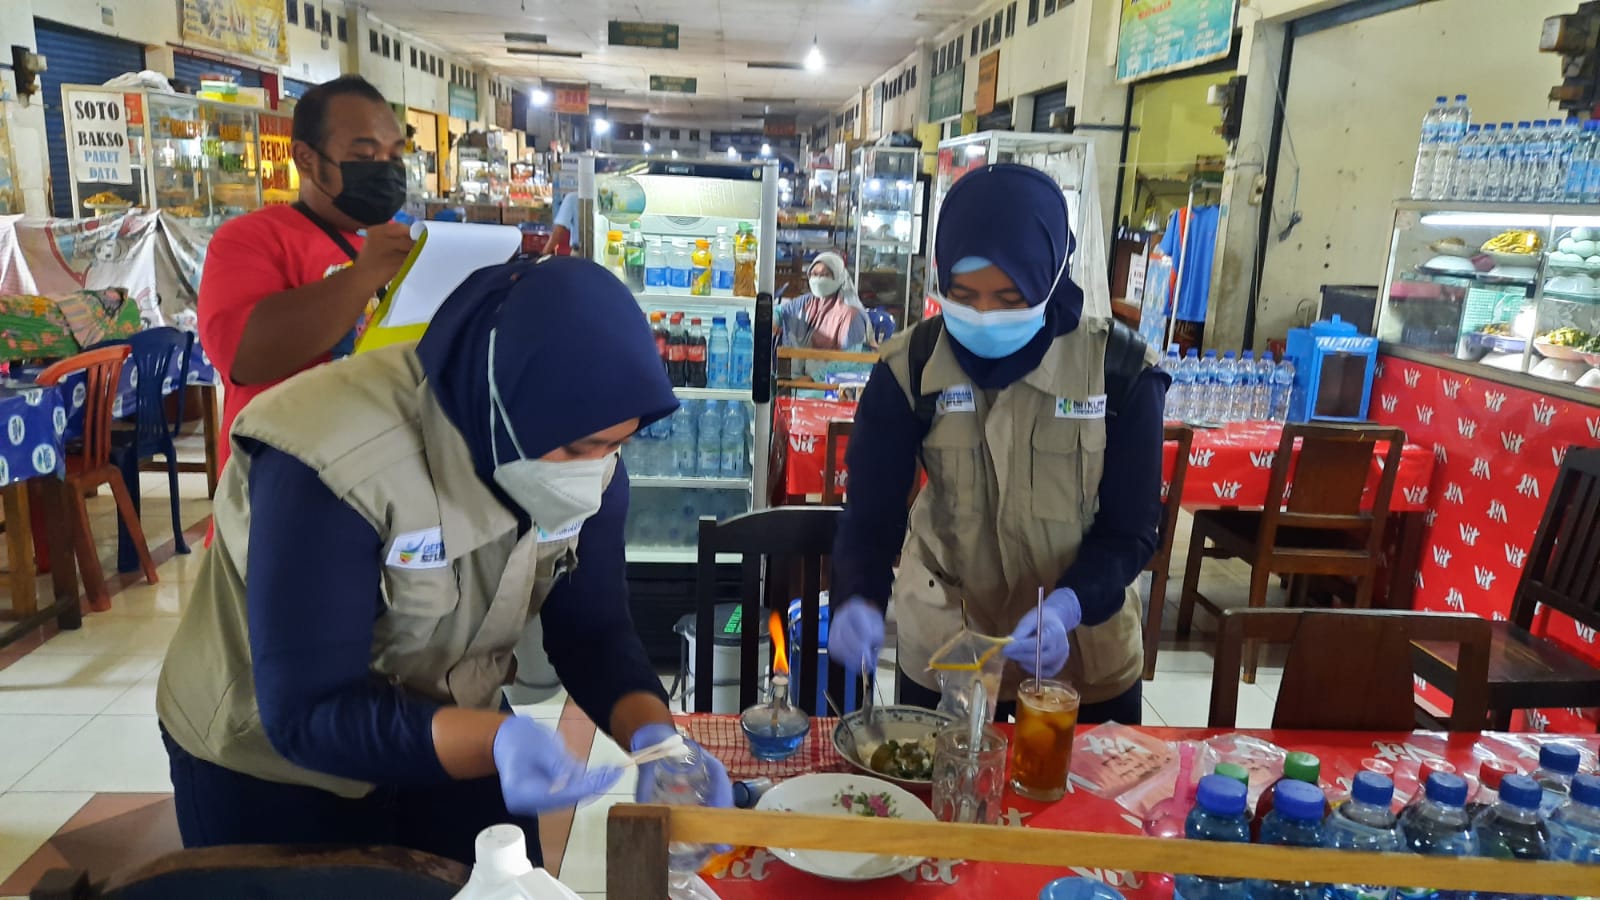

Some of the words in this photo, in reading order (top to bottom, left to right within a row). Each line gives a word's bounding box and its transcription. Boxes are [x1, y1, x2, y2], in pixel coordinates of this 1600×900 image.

[74, 100, 120, 121] SOTO
[78, 130, 124, 147] BAKSO
[84, 150, 120, 164] PAKET
[89, 167, 119, 181] DATA
[1403, 368, 1421, 388] Vit
[1443, 377, 1462, 399] Vit
[1381, 393, 1398, 413] Vit
[1485, 389, 1507, 412] Vit
[1532, 398, 1557, 426] Vit
[1416, 404, 1434, 425] Vit
[1457, 416, 1477, 439] Vit
[1586, 416, 1600, 441] Vi
[790, 431, 819, 454] Vit
[1500, 431, 1524, 454] Vit
[1188, 447, 1215, 468] Vit
[1552, 445, 1567, 468] Vi
[1470, 457, 1491, 480] Vit
[1212, 480, 1242, 499] Vit
[1402, 485, 1428, 504] Vit
[1444, 482, 1464, 504] Vit
[1516, 474, 1540, 498] Vit
[1486, 500, 1508, 524] Vit
[1459, 522, 1480, 546] Vit
[1433, 544, 1452, 568] Vit
[1504, 542, 1526, 568] Vit
[1474, 565, 1496, 590] Vit
[1445, 587, 1465, 612] Vit
